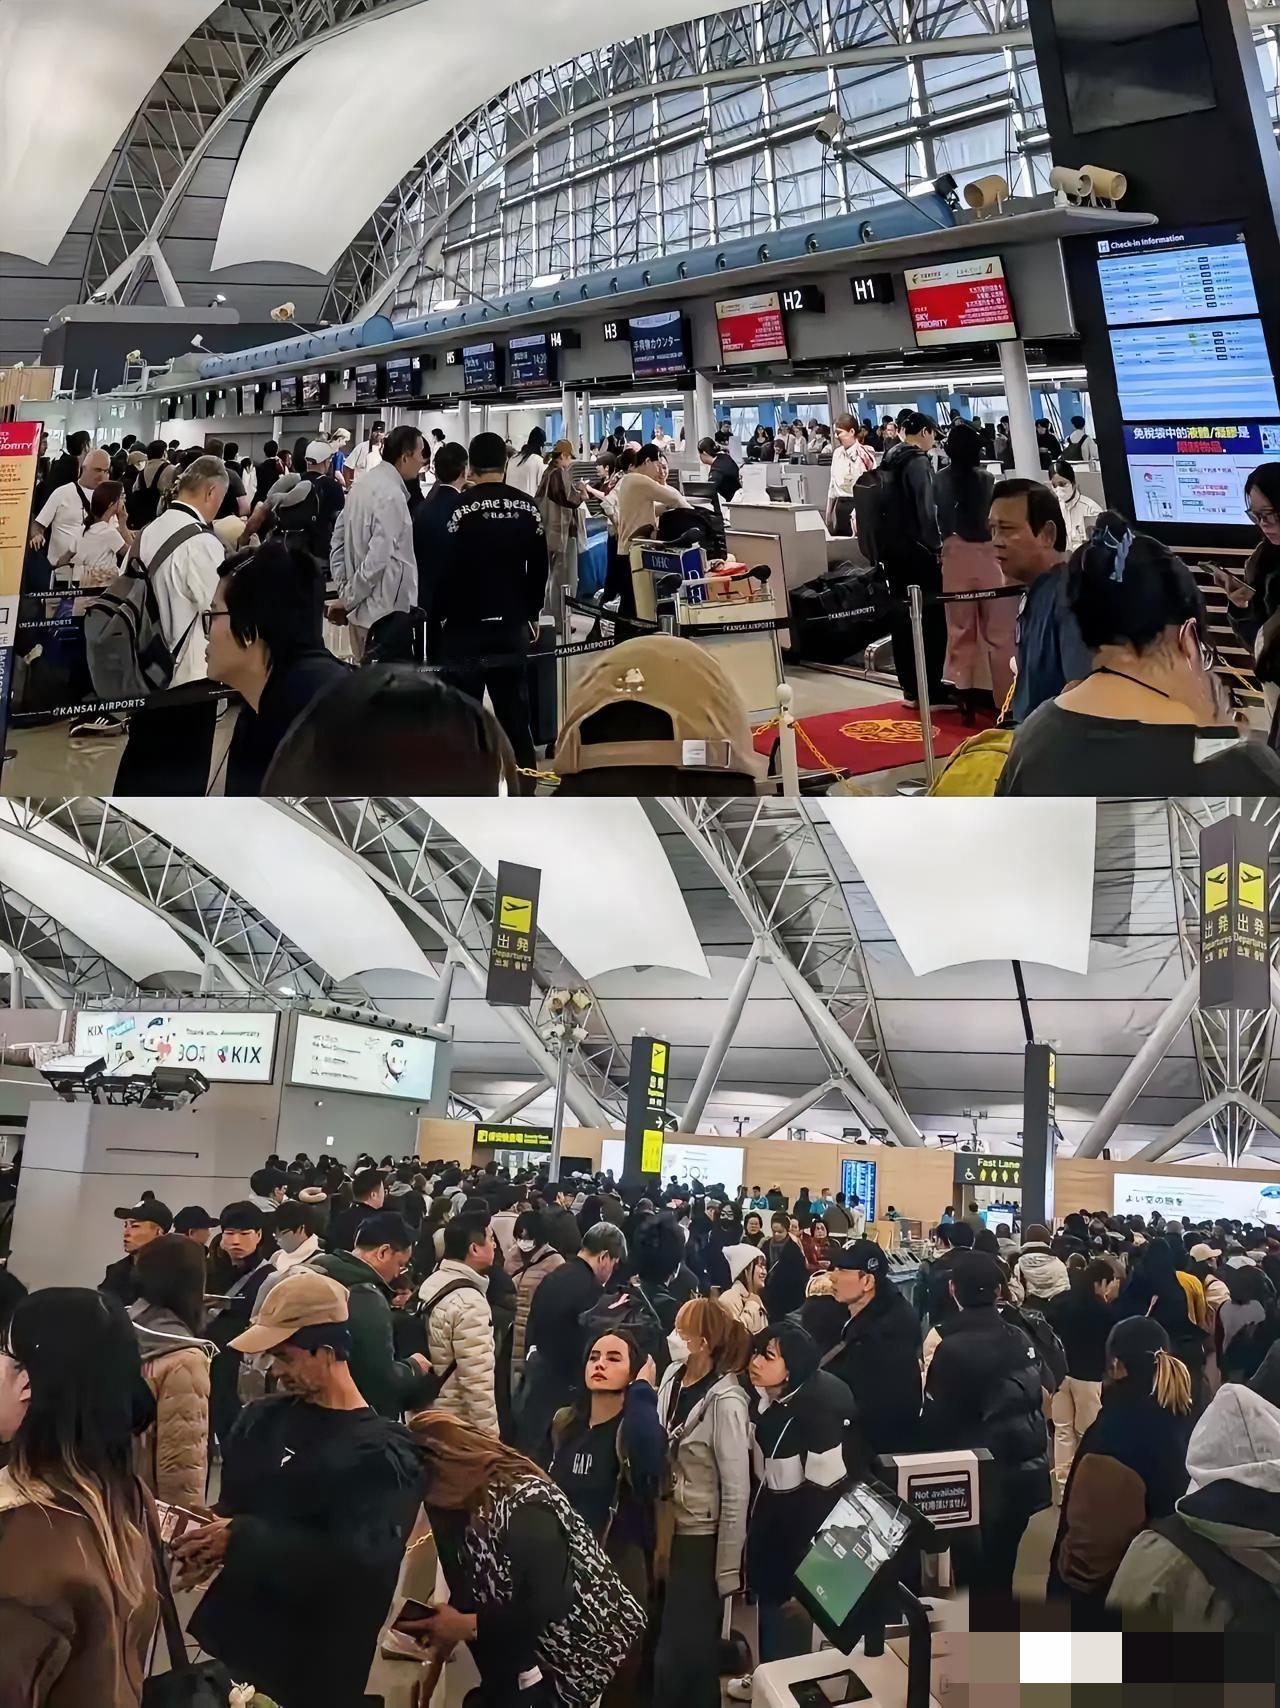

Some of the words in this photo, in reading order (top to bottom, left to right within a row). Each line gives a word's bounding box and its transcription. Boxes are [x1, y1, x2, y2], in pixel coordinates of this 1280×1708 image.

[1111, 239, 1141, 249] Check-in
[855, 278, 875, 300] H1
[783, 290, 803, 311] H2
[915, 313, 929, 322] SKY
[916, 319, 948, 329] PRIORITY
[604, 323, 618, 340] H3
[550, 332, 562, 347] H4
[39, 618, 72, 628] AIRPORTS
[558, 646, 583, 655] KANSAI
[584, 639, 615, 651] AIRPORTS
[60, 704, 97, 715] KANSAI
[98, 698, 146, 711] AIRPORTS
[87, 1024, 104, 1037] KIX
[231, 1045, 262, 1064] KIX
[977, 1157, 997, 1168] Fast
[998, 1159, 1021, 1169] Lane
[572, 1453, 593, 1475] GAP
[914, 1490, 930, 1500] Not
[930, 1487, 966, 1498] available
